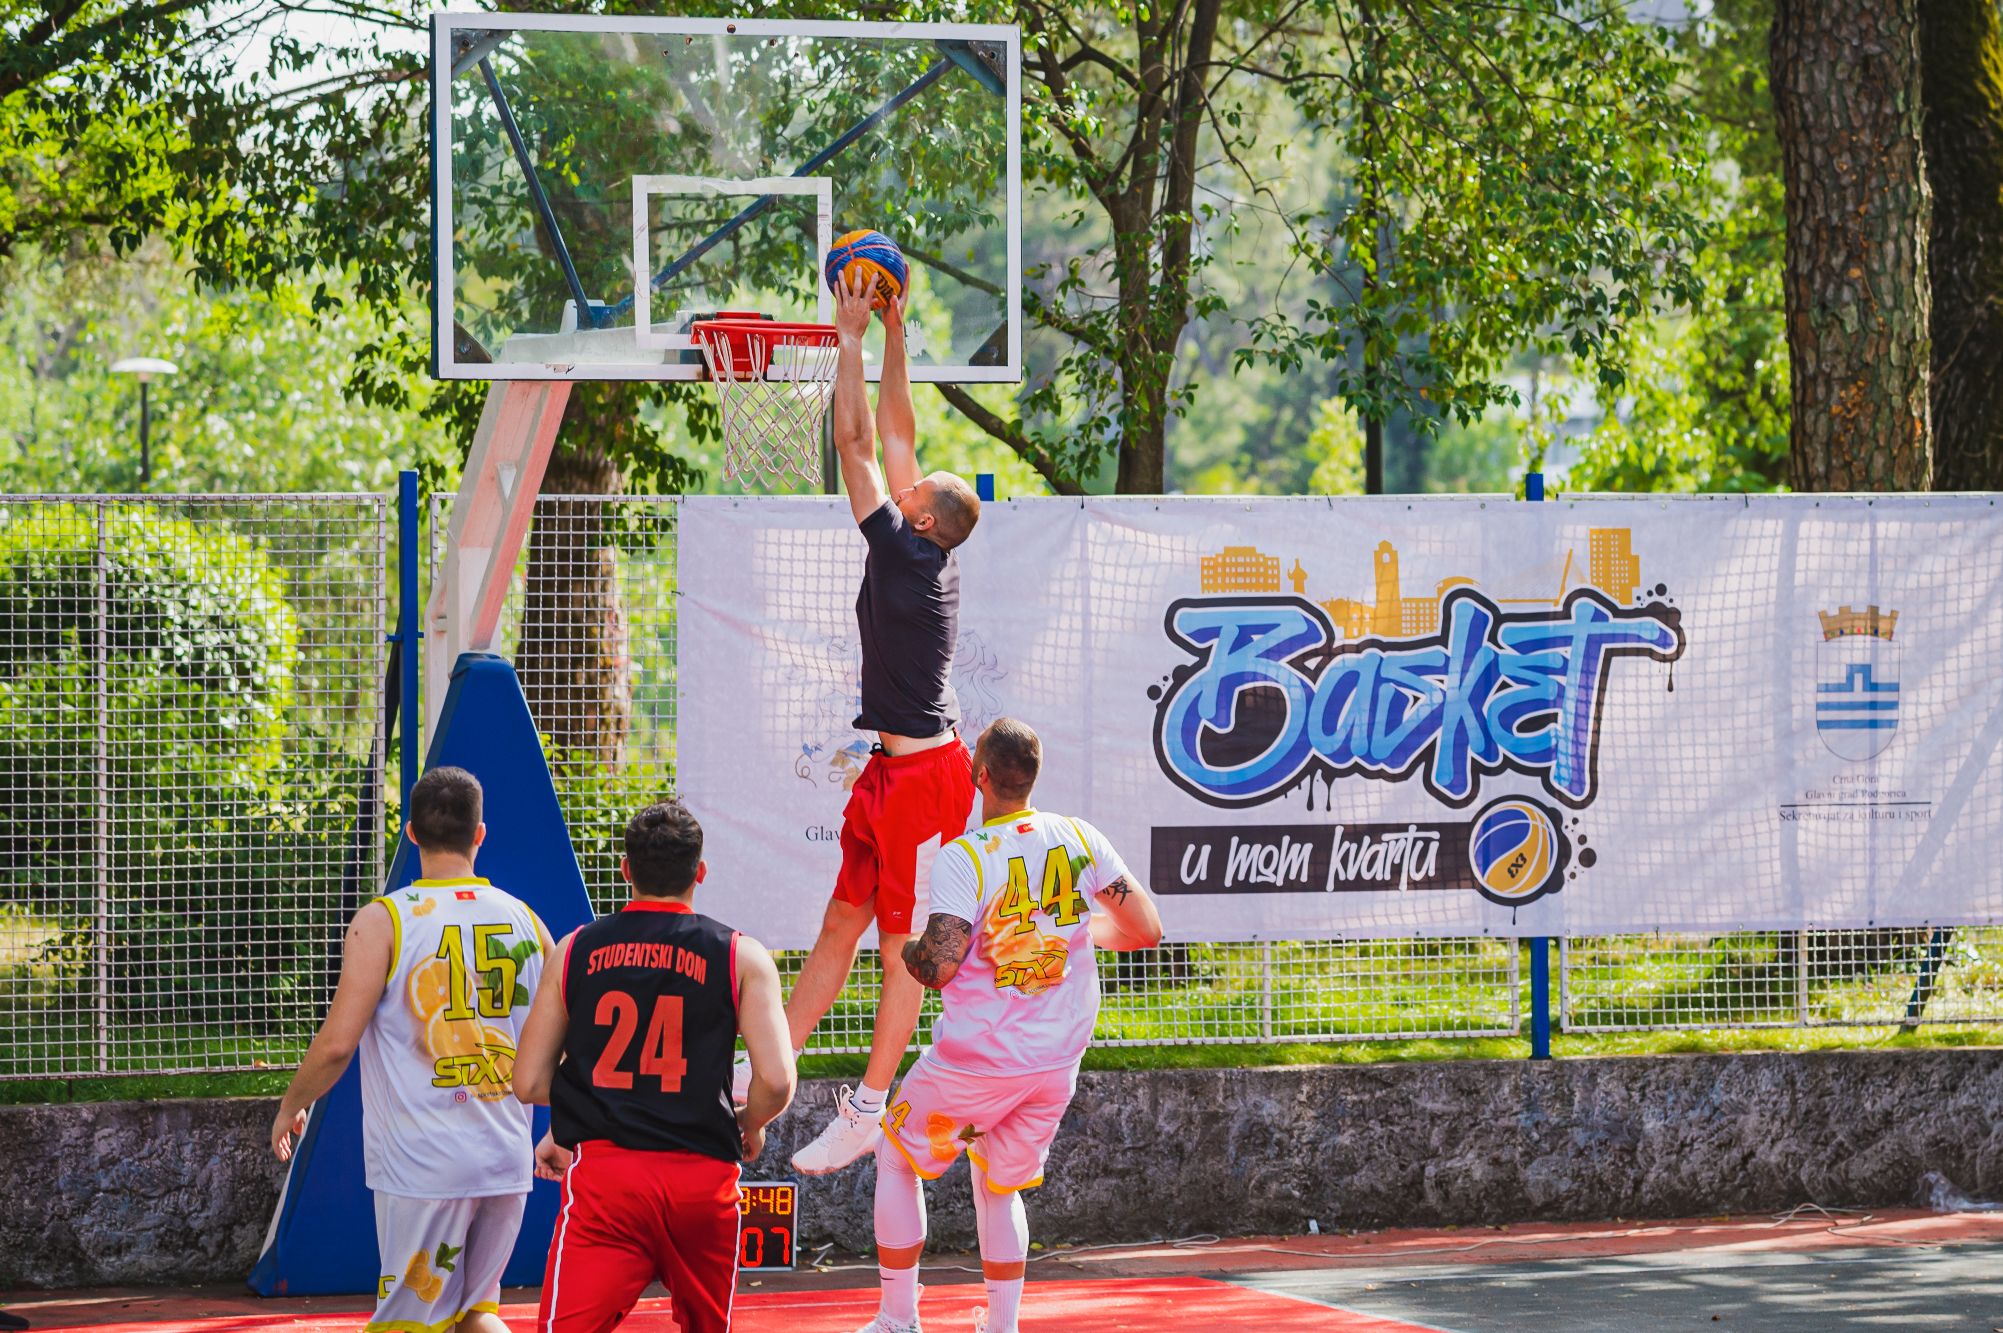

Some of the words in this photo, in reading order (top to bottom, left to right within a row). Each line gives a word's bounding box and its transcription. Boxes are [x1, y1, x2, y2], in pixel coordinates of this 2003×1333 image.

[1861, 788, 1907, 800] Podorica
[1905, 808, 1932, 822] sport
[805, 825, 840, 842] Glav
[1180, 843, 1211, 885] u
[1224, 835, 1313, 887] mom
[1326, 824, 1440, 892] kvartu
[1000, 844, 1084, 935] 44
[435, 922, 518, 1022] 15
[587, 942, 674, 976] STUDENTSKI
[675, 946, 707, 985] DOM
[592, 990, 687, 1093] 24
[740, 1226, 791, 1267] 07
